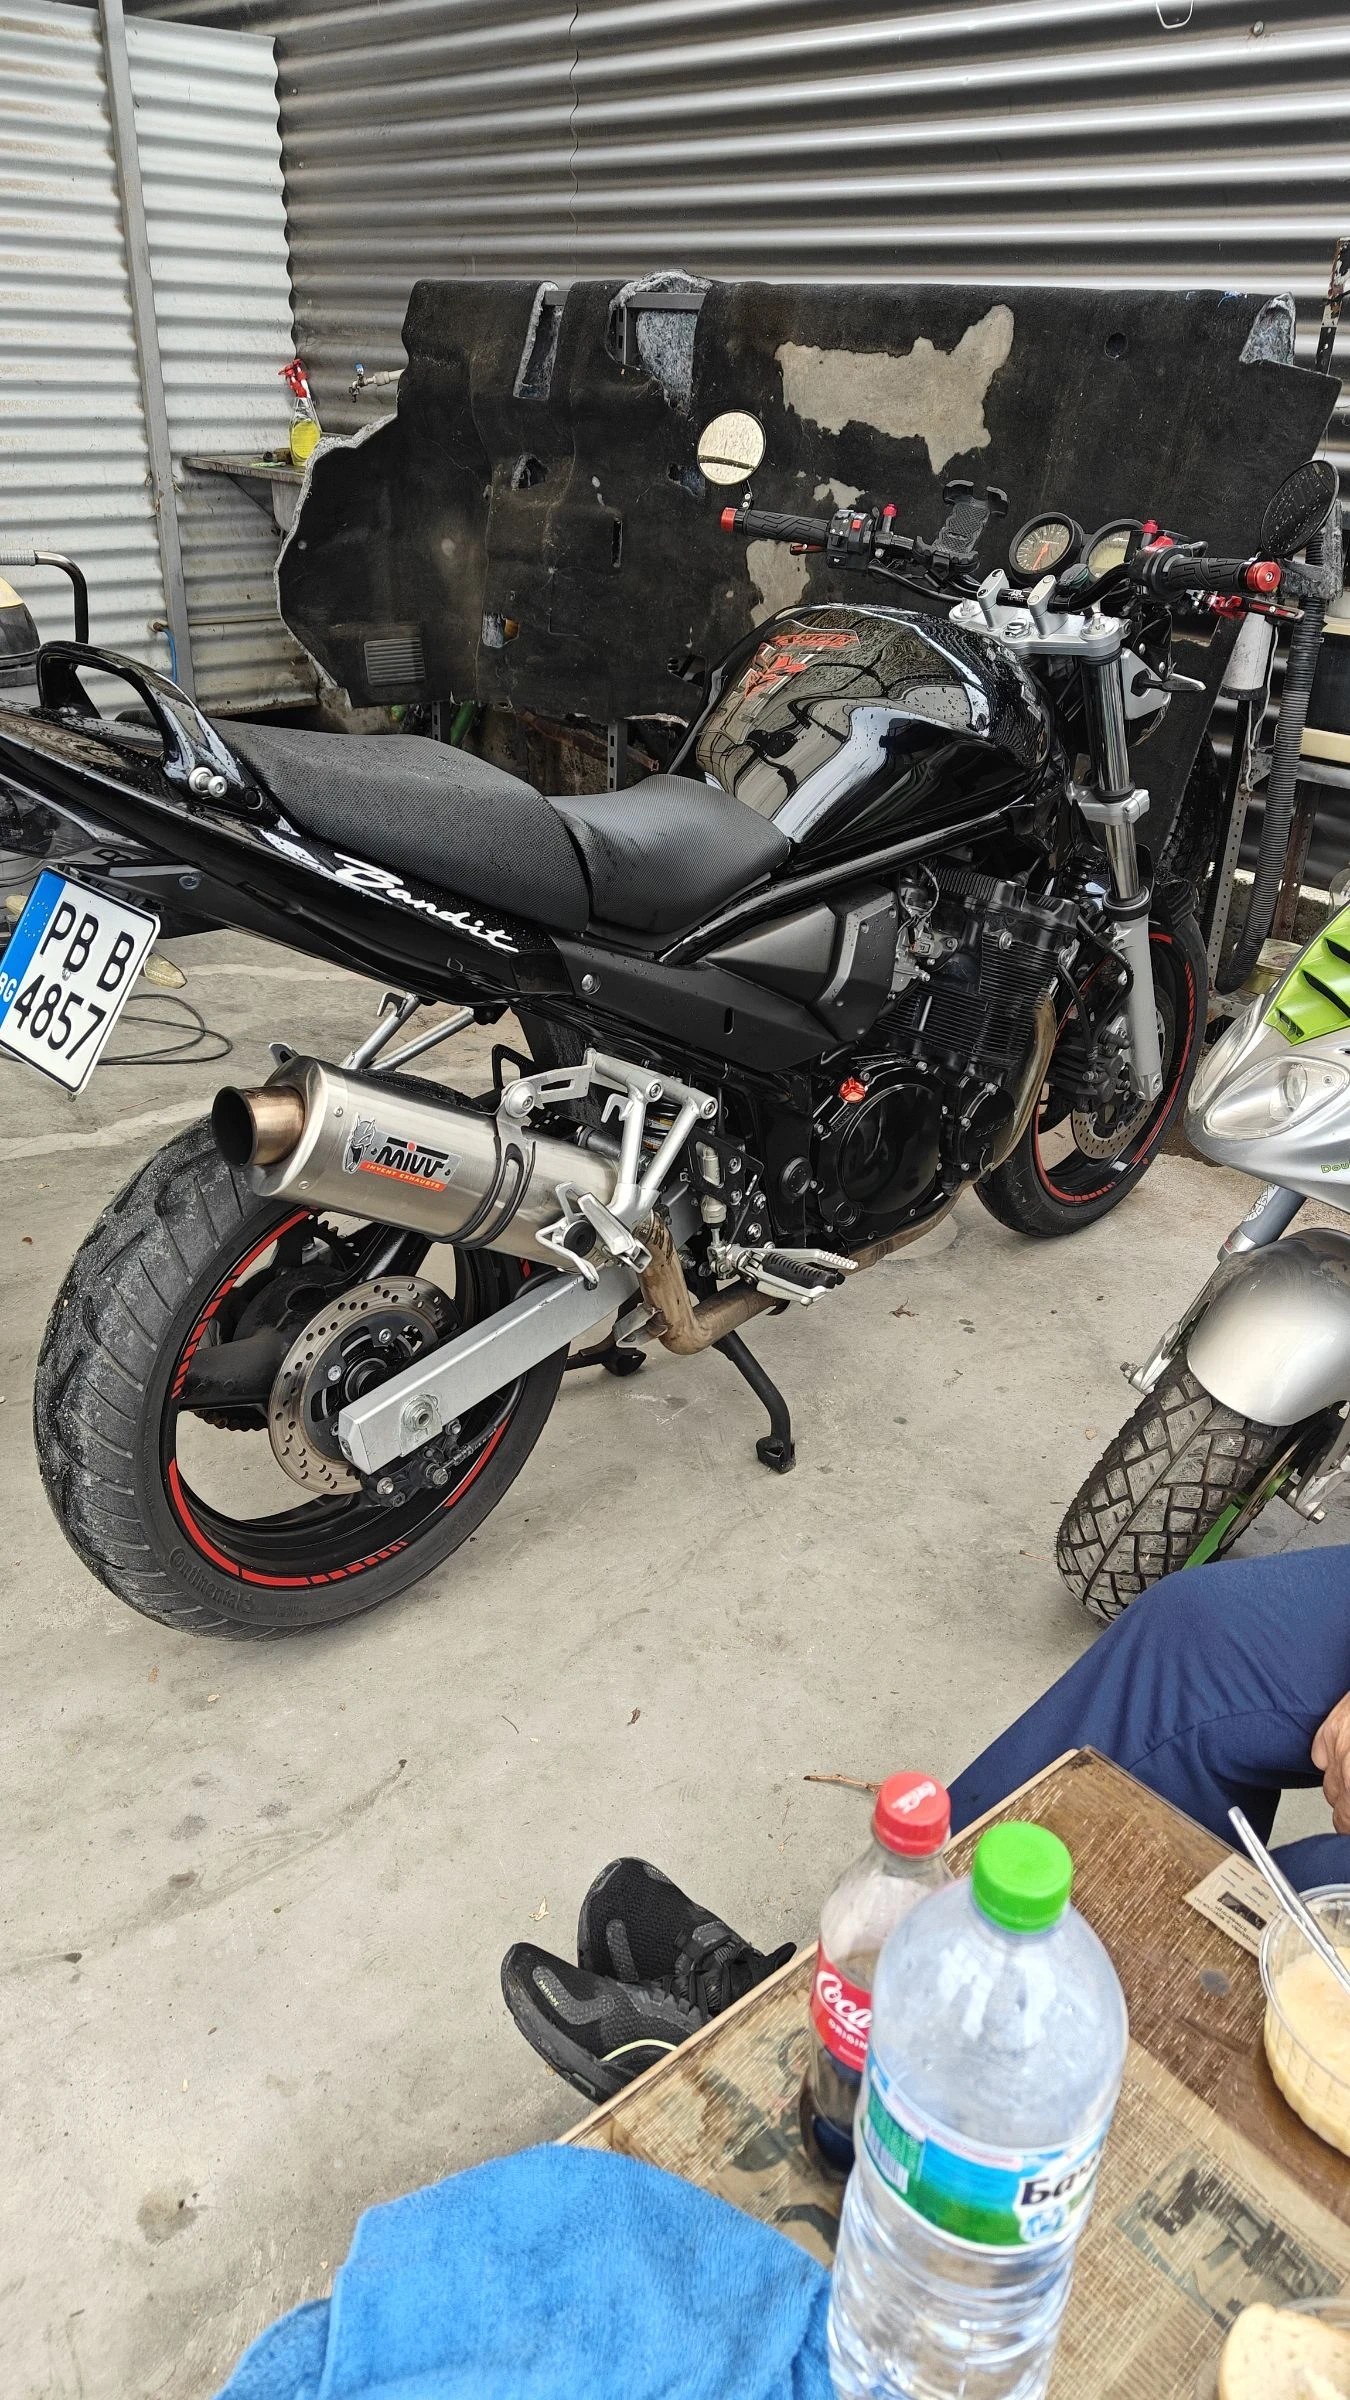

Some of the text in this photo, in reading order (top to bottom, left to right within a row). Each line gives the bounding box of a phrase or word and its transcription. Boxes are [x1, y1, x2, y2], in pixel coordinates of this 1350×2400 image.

[334, 852, 519, 953] Bandit
[40, 901, 135, 992] PB B
[14, 974, 107, 1060] 4857
[366, 1164, 441, 1189] INVENT EXHAUSTS
[1320, 1159, 1350, 1174] Dou
[168, 1546, 241, 1612] Continental
